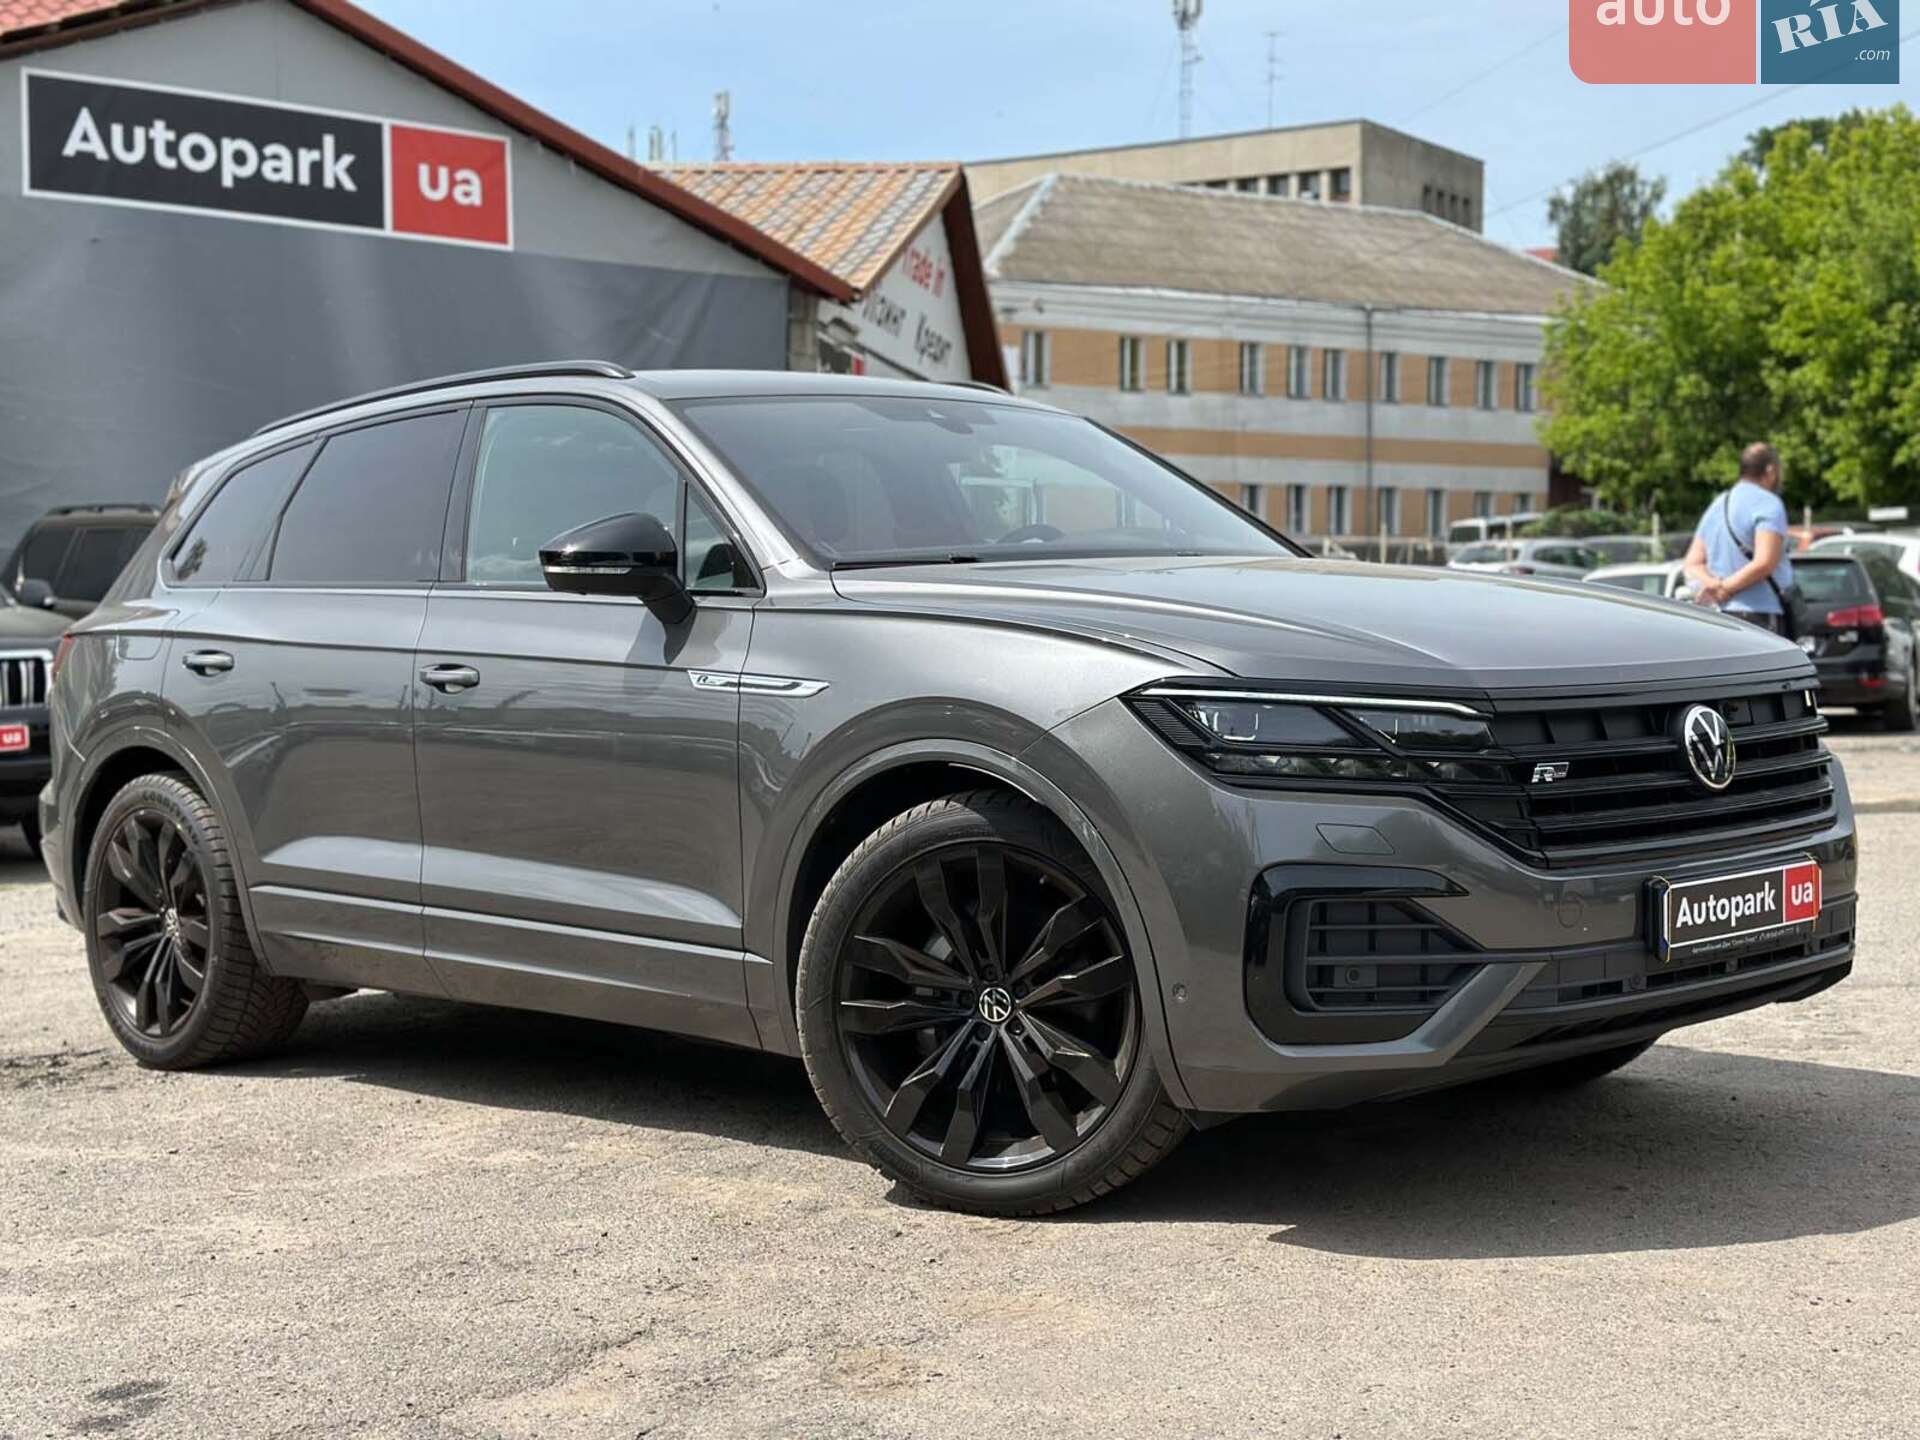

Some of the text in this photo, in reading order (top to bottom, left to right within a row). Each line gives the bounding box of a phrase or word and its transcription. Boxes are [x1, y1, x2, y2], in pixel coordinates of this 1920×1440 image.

[61, 105, 483, 207] Autopark ua
[1675, 880, 1814, 928] Autopark ua
